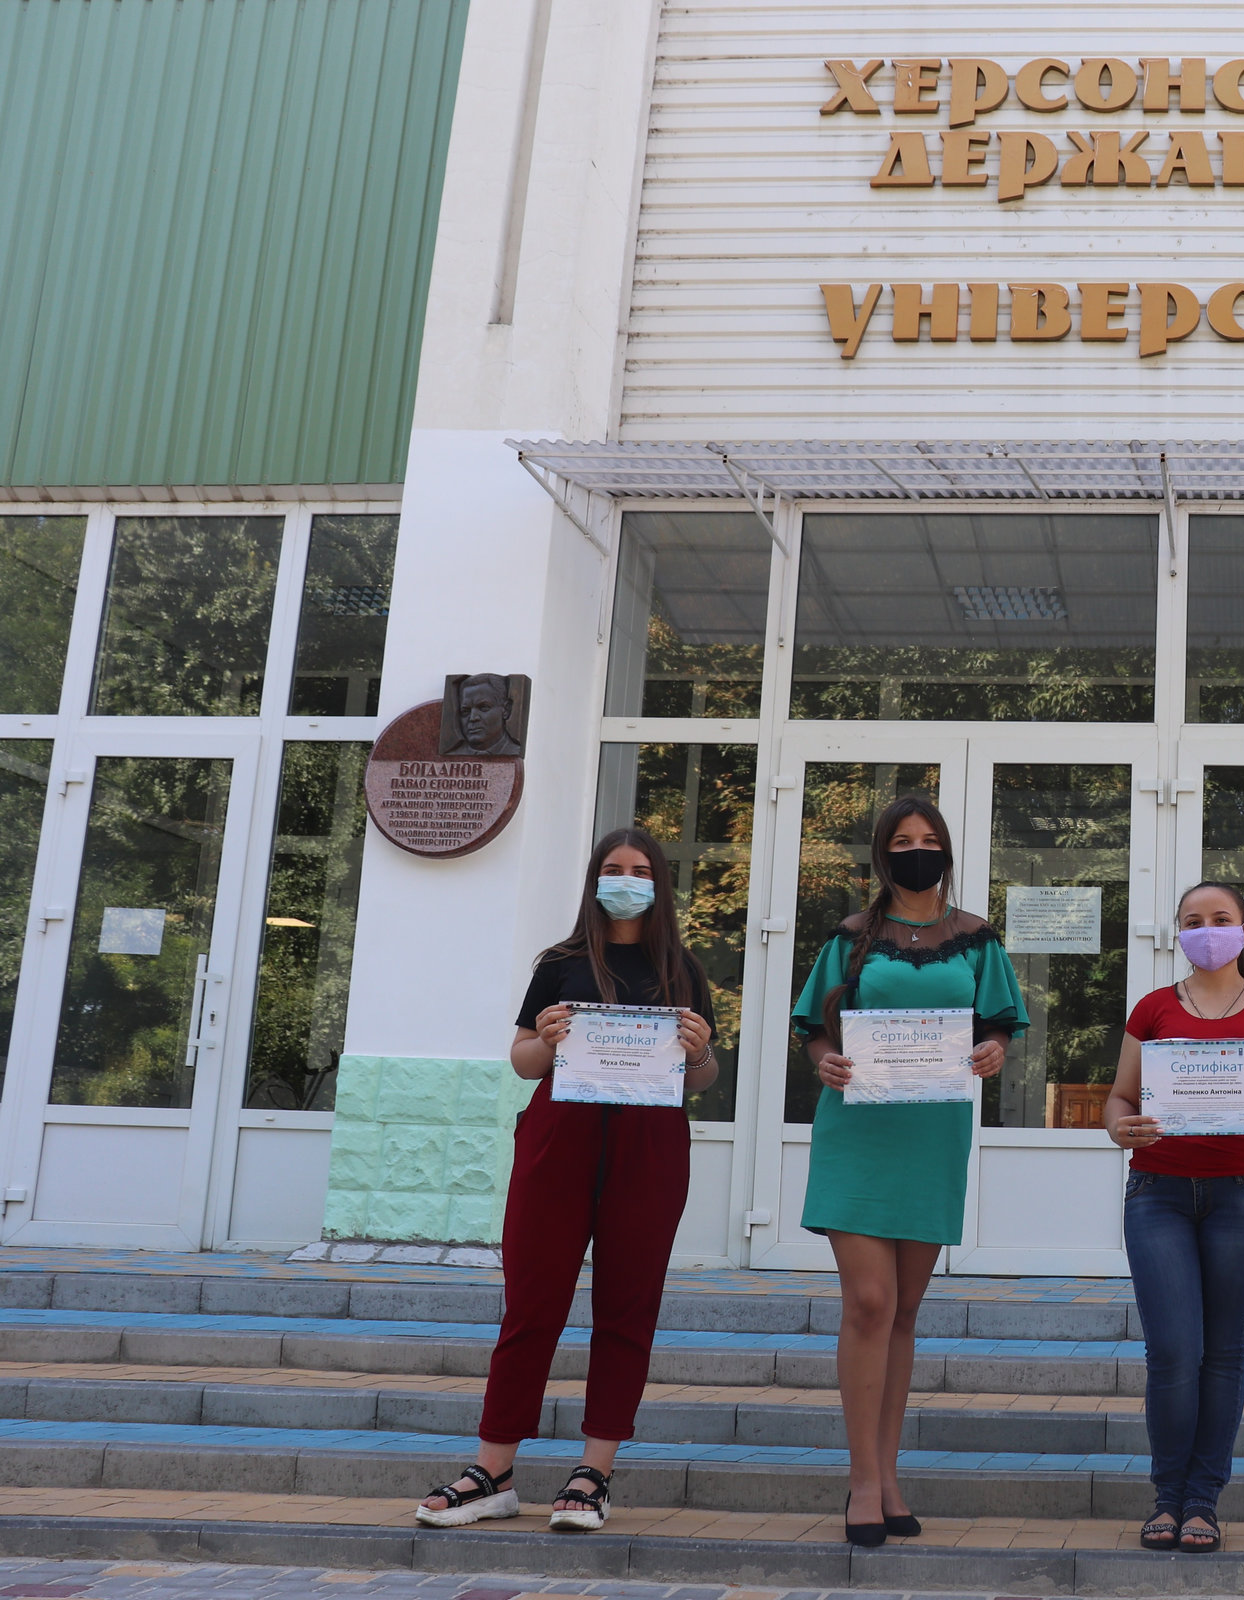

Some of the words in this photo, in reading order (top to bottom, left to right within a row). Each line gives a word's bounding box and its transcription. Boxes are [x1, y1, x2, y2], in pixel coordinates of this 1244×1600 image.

[399, 762, 483, 777] БОГДАНОВ
[392, 790, 421, 799] РЕКТОР
[424, 791, 485, 800] ХЕРСОНСЬКОГО
[586, 1031, 658, 1047] Сертифікат
[871, 1029, 944, 1044] Сертифікат
[619, 1060, 641, 1068] Олена
[1170, 1060, 1244, 1075] Сертифікат
[1172, 1088, 1209, 1096] Ніколенко
